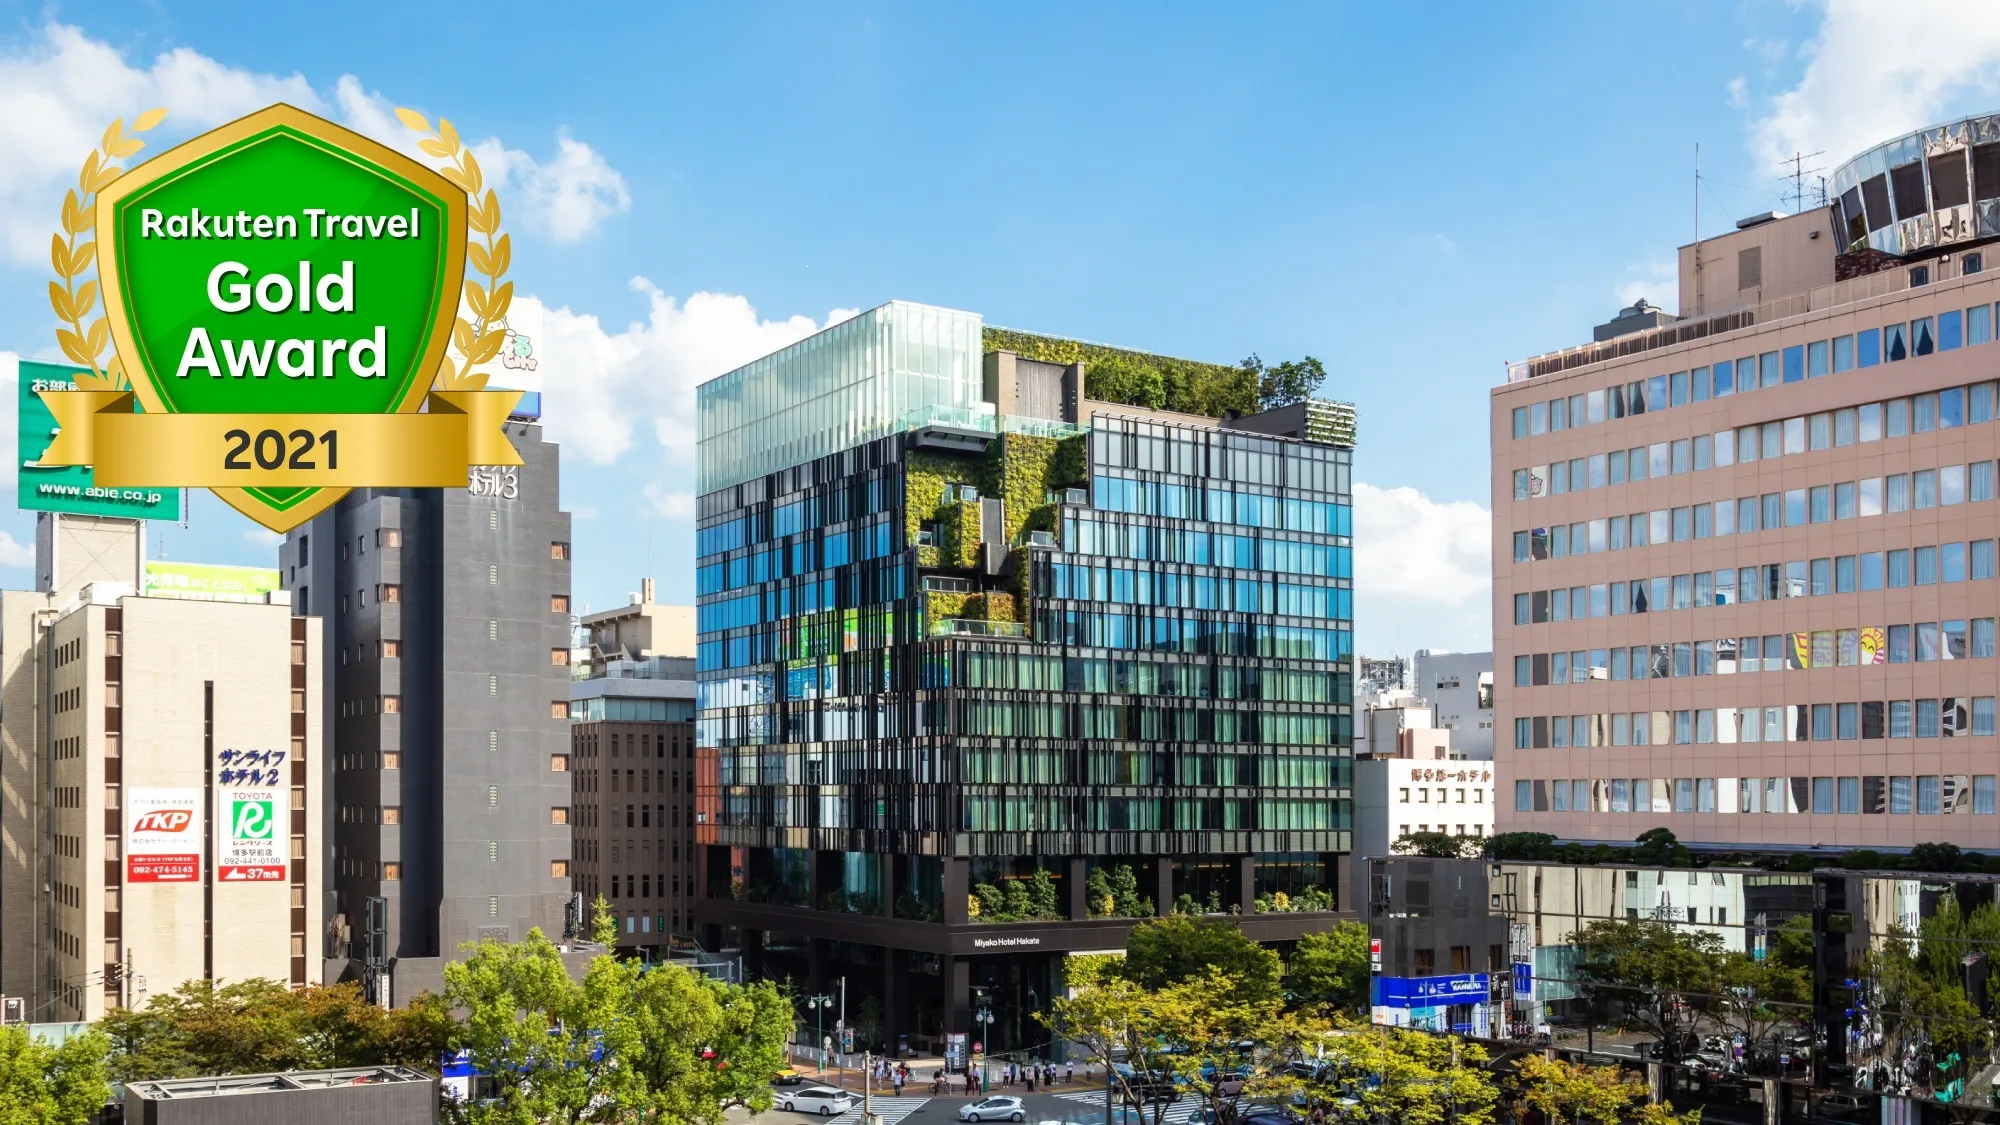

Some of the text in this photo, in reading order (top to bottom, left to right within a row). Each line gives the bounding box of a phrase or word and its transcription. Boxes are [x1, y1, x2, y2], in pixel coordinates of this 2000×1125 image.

[469, 471, 518, 498] ホテル3
[39, 483, 161, 503] www.able.co.jp
[218, 749, 286, 767] サンライフ
[218, 768, 279, 787] ホテル2
[232, 792, 273, 800] TOYOTA
[138, 812, 189, 830] TKP
[232, 848, 273, 857] 博多駅前店
[224, 857, 281, 865] 092-441-0100
[133, 865, 194, 874] 092-474-5145
[974, 937, 1040, 948] Miyako Hotel Hakata
